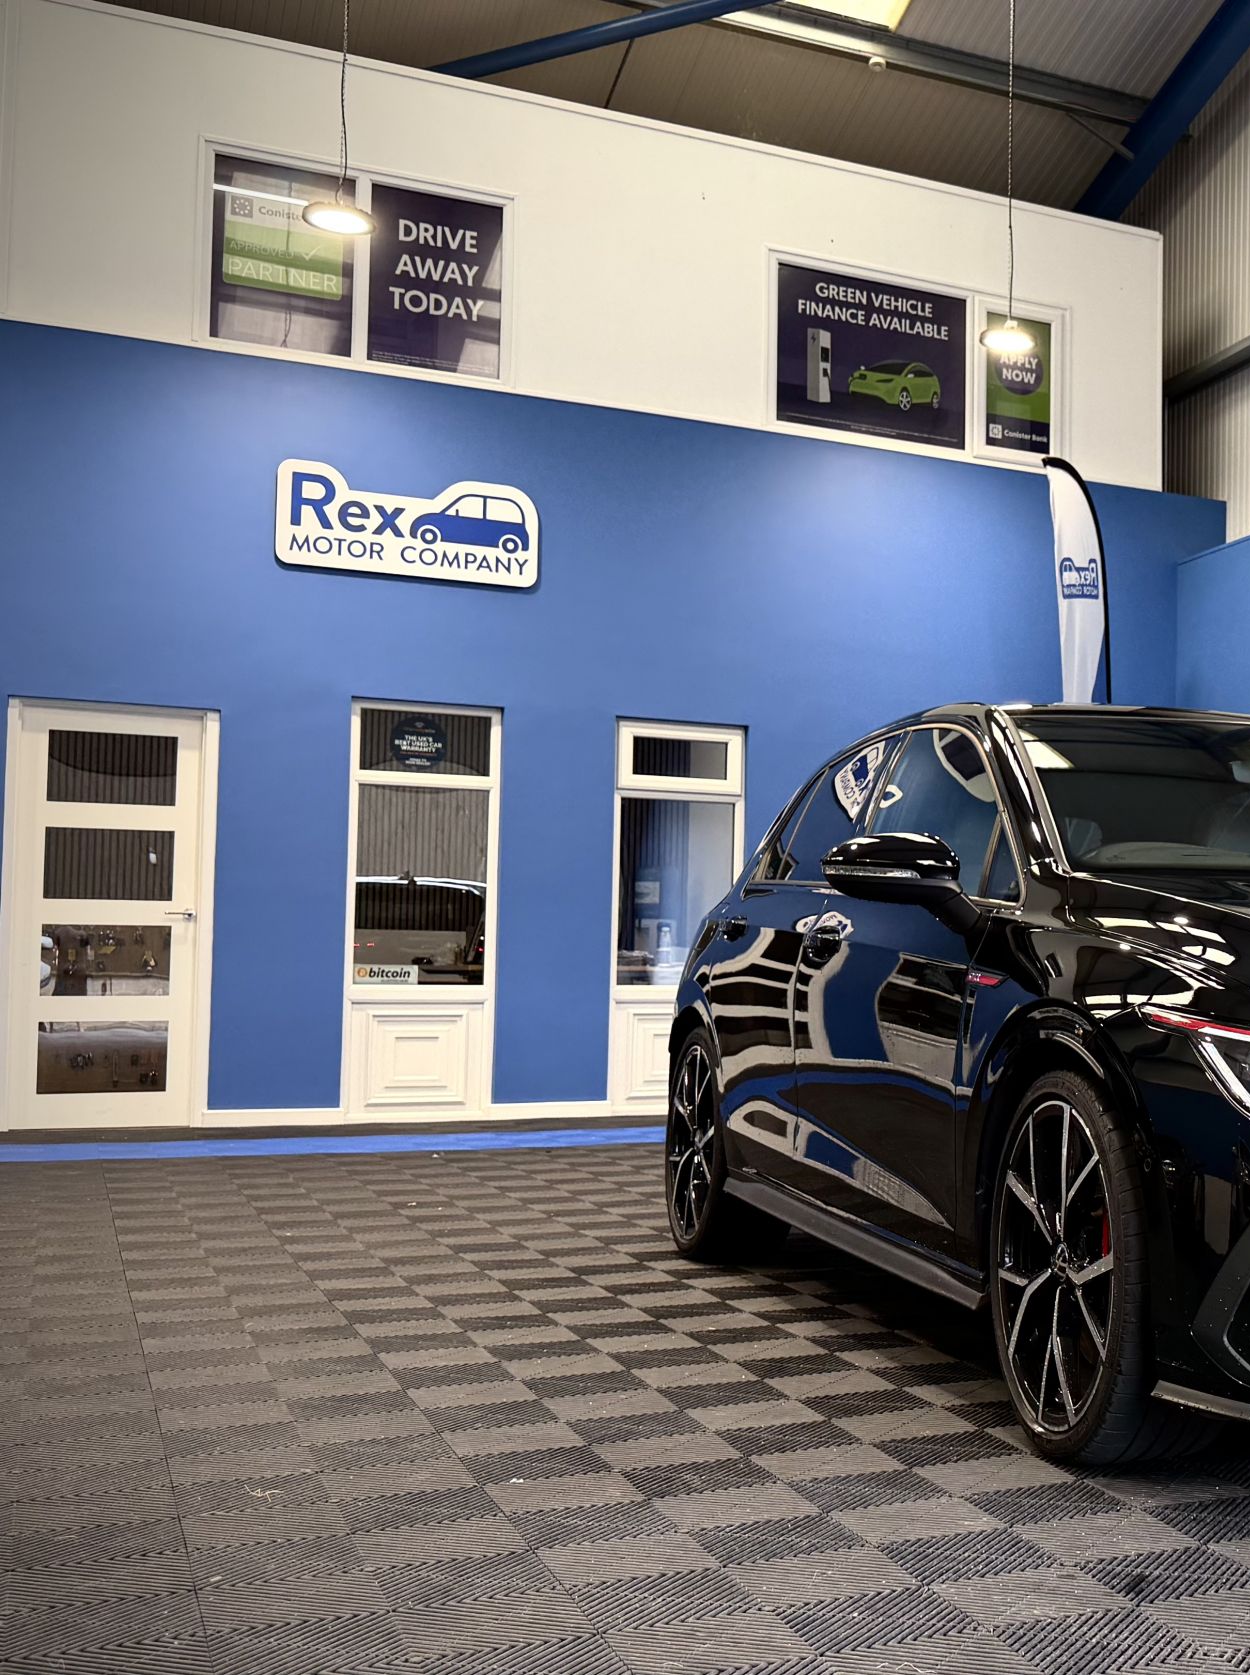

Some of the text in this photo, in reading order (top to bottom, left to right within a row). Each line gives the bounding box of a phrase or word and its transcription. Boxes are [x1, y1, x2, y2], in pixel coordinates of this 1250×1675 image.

[398, 218, 478, 253] DRIVE
[228, 257, 338, 292] PARTNER
[395, 254, 479, 287] AWAY
[388, 286, 484, 322] TODAY
[815, 282, 933, 318] GREEN VEHICLE
[798, 299, 949, 341] FINANCE AVAILABLE
[1000, 353, 1038, 369] APPLY
[1002, 368, 1036, 384] NOW
[290, 471, 406, 538] Rex
[289, 533, 529, 576] MOTOR COMPANY
[368, 967, 411, 979] bitcoin
